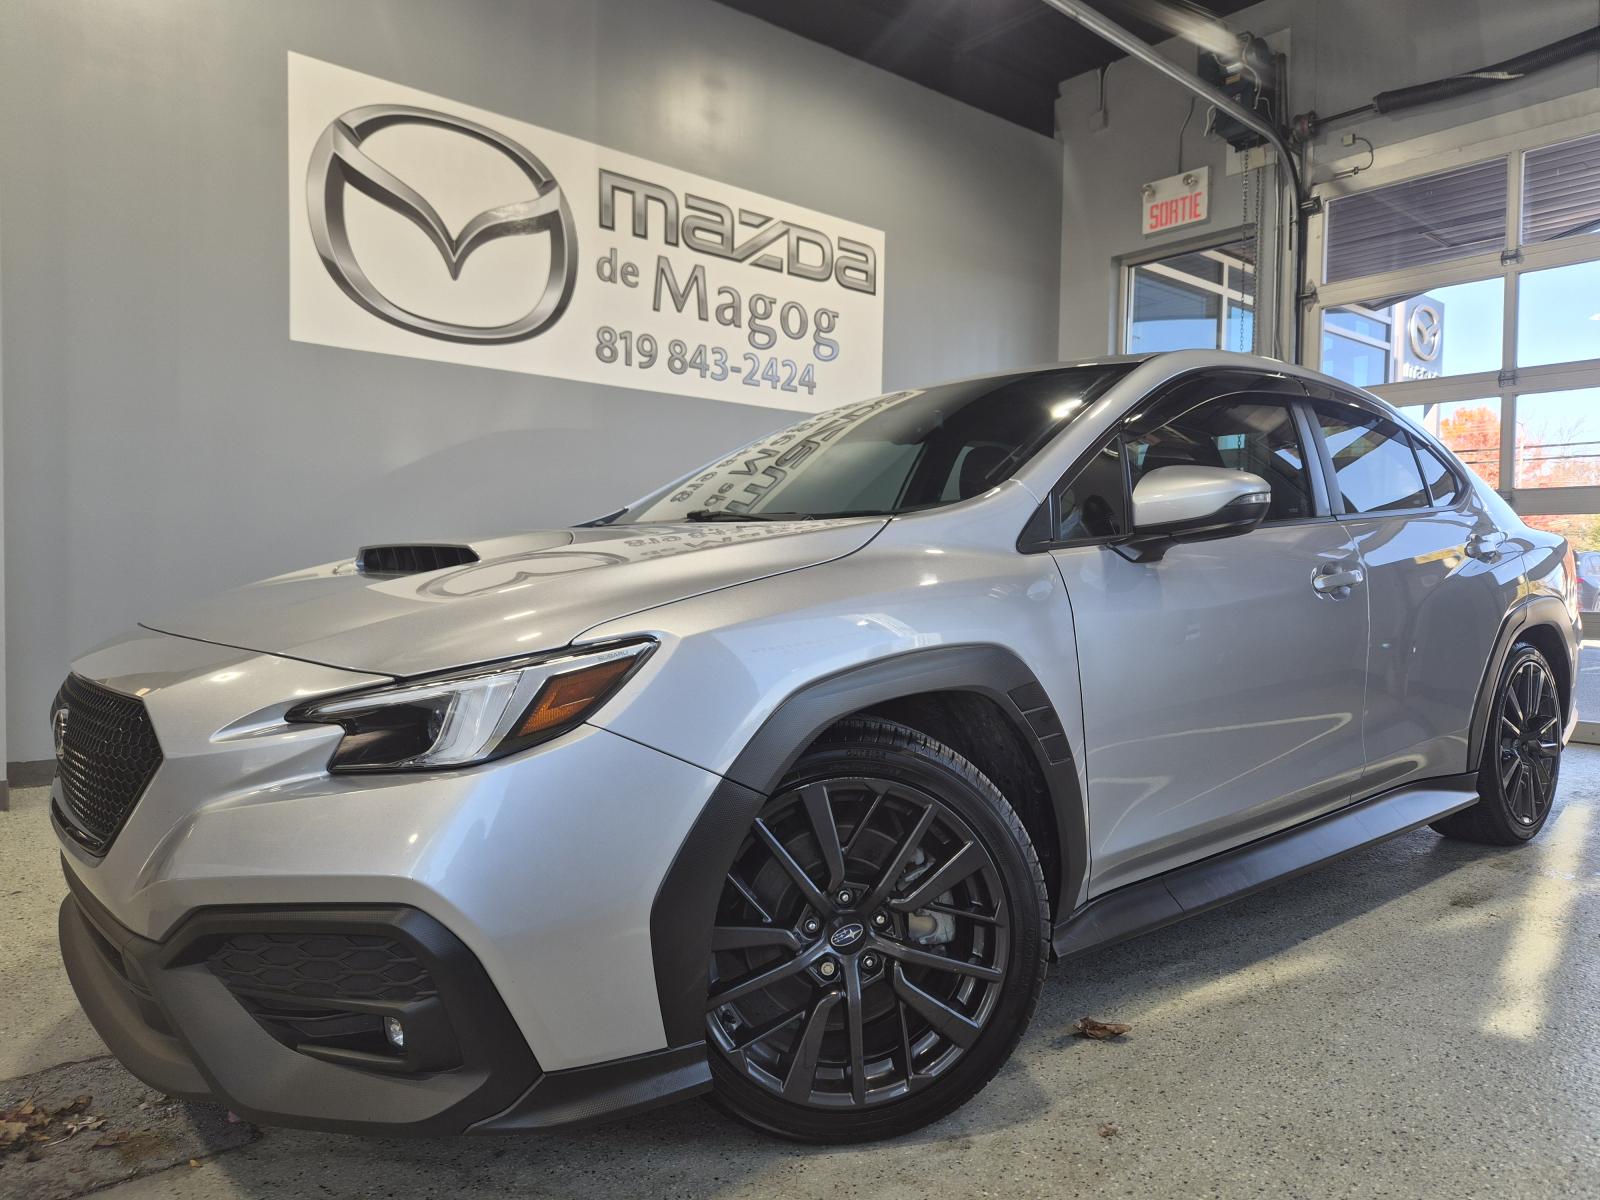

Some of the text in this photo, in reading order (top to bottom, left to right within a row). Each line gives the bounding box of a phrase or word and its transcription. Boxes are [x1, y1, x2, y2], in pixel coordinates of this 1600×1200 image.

[1149, 191, 1203, 230] SORTIE
[596, 247, 840, 362] de Magog
[595, 325, 816, 395] 819 843-2424
